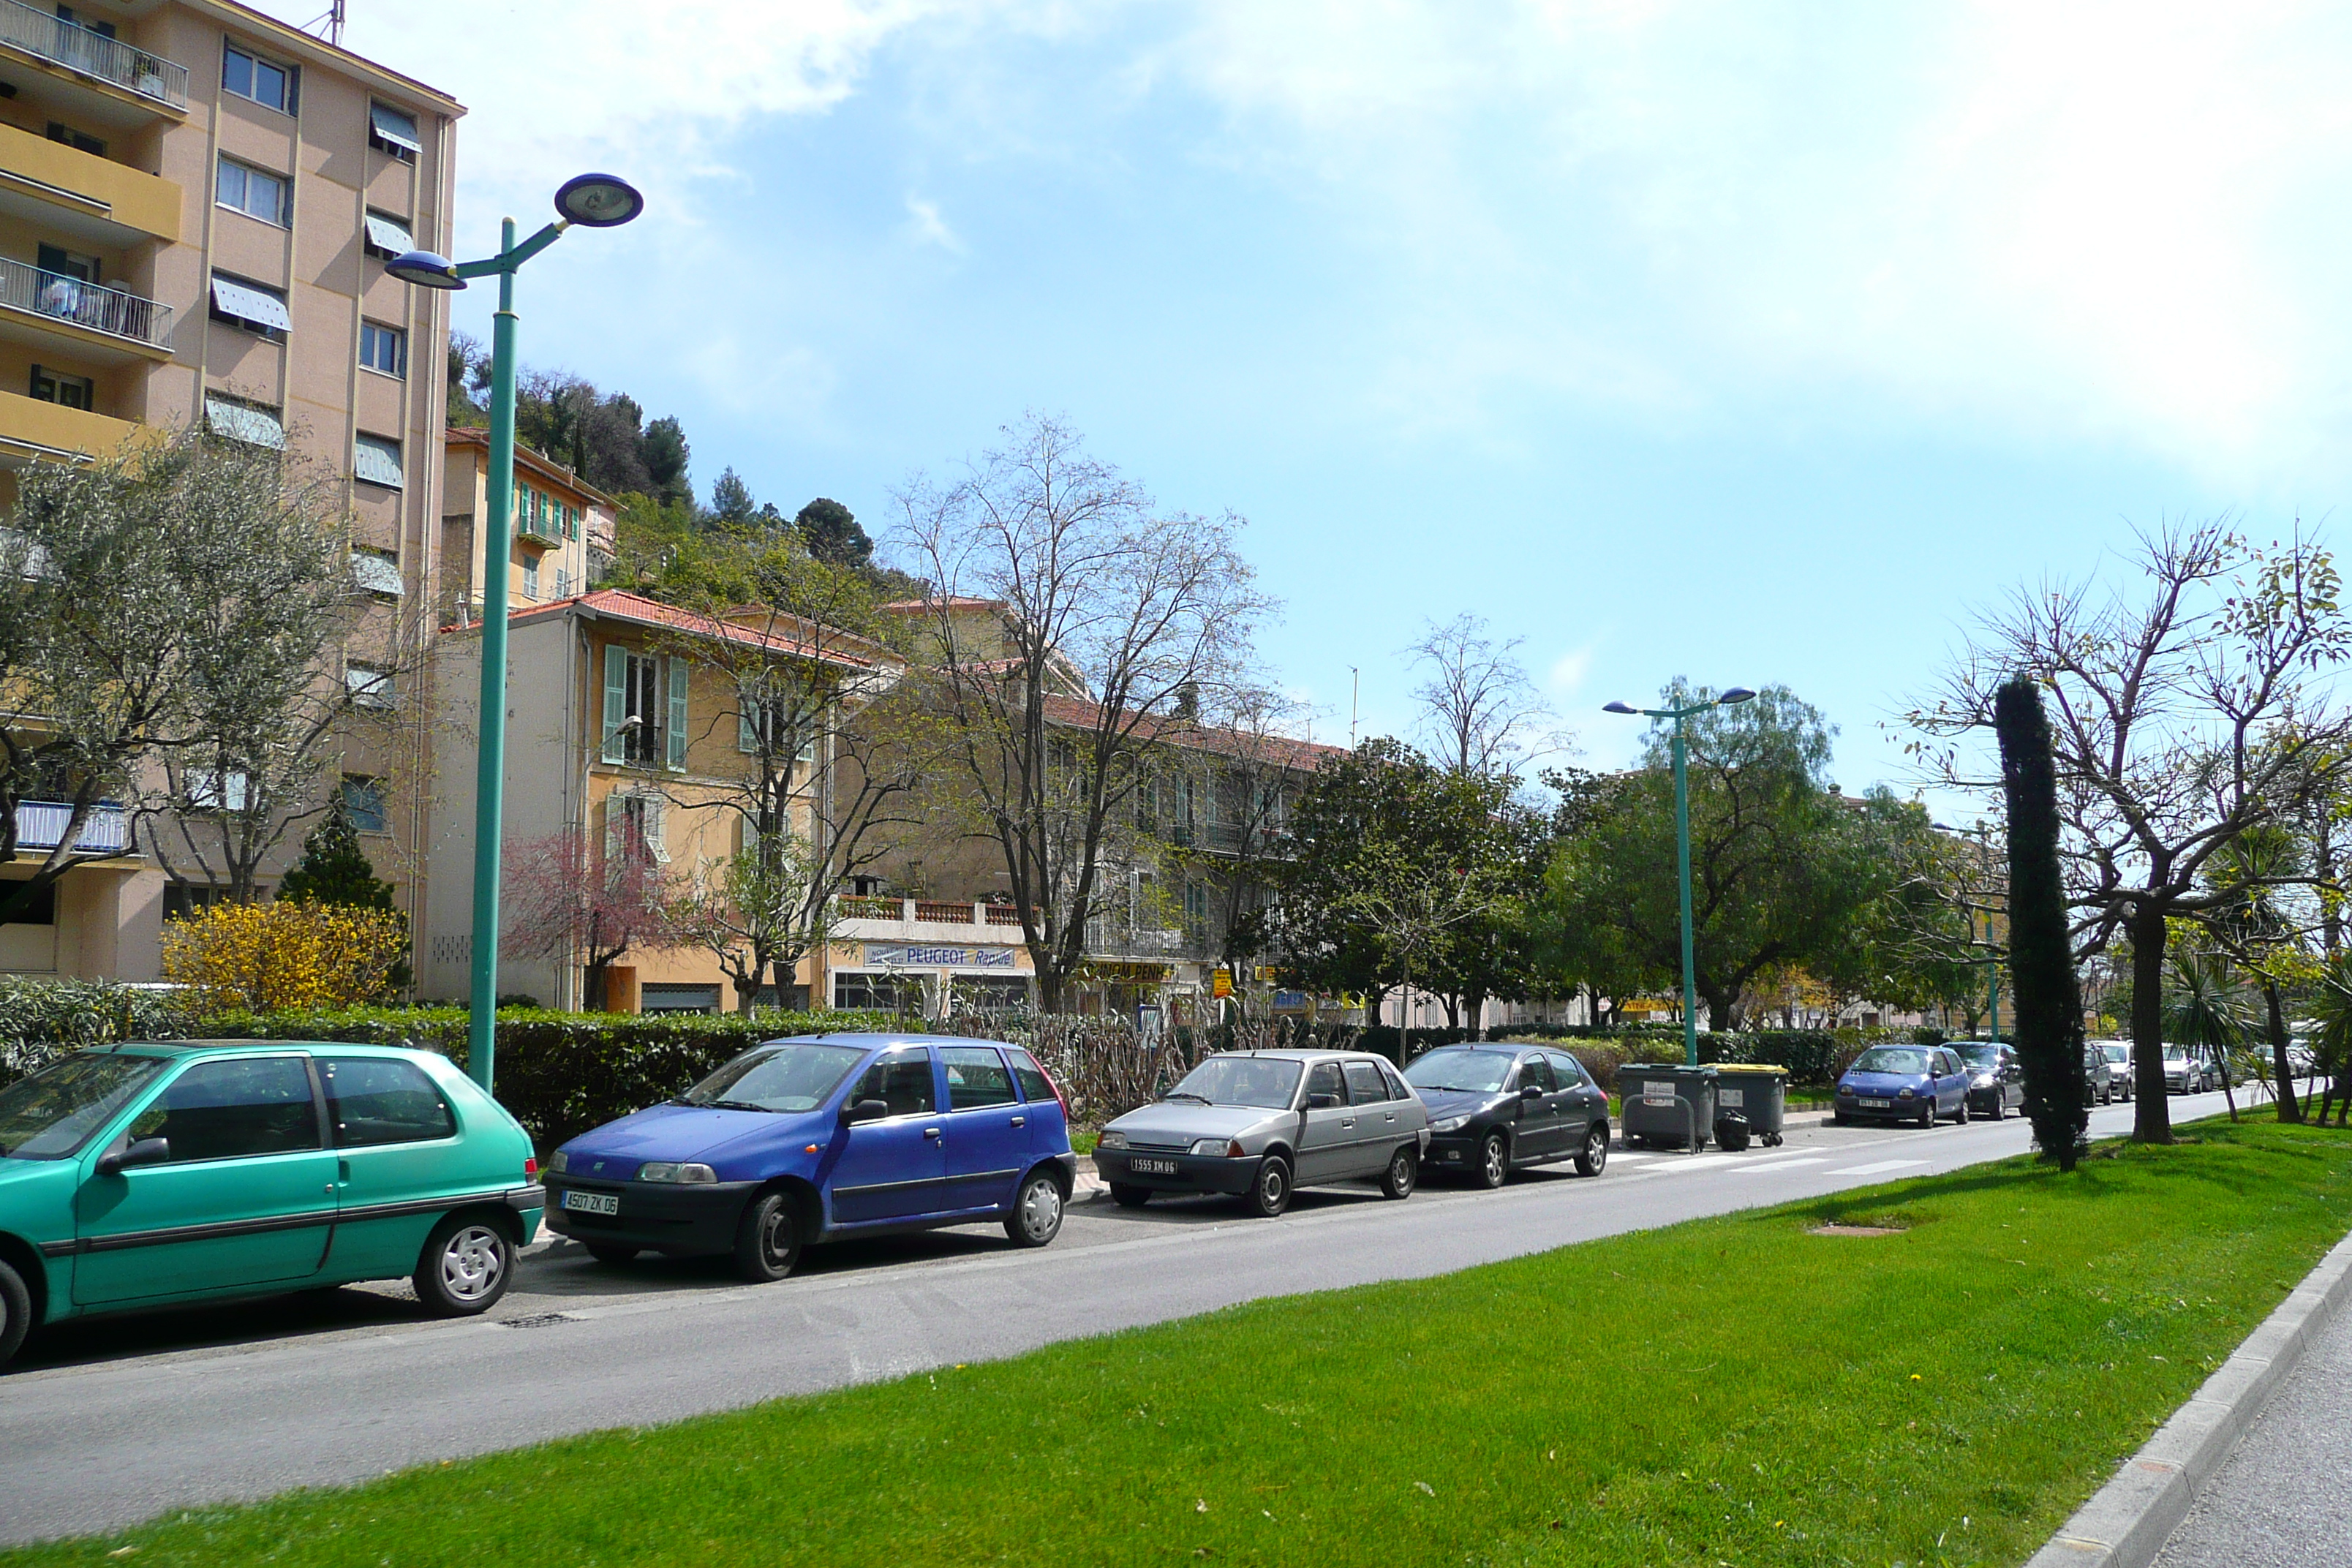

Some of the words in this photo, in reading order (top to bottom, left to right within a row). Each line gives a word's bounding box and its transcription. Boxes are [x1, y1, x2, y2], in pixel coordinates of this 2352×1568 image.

[908, 948, 966, 963] PEUGEOT
[1135, 964, 1165, 981] PENH
[1134, 1158, 1152, 1170] 1555
[1164, 1161, 1175, 1172] 06
[568, 1193, 588, 1208] 4507
[590, 1196, 601, 1210] ZK
[605, 1198, 616, 1213] 06
